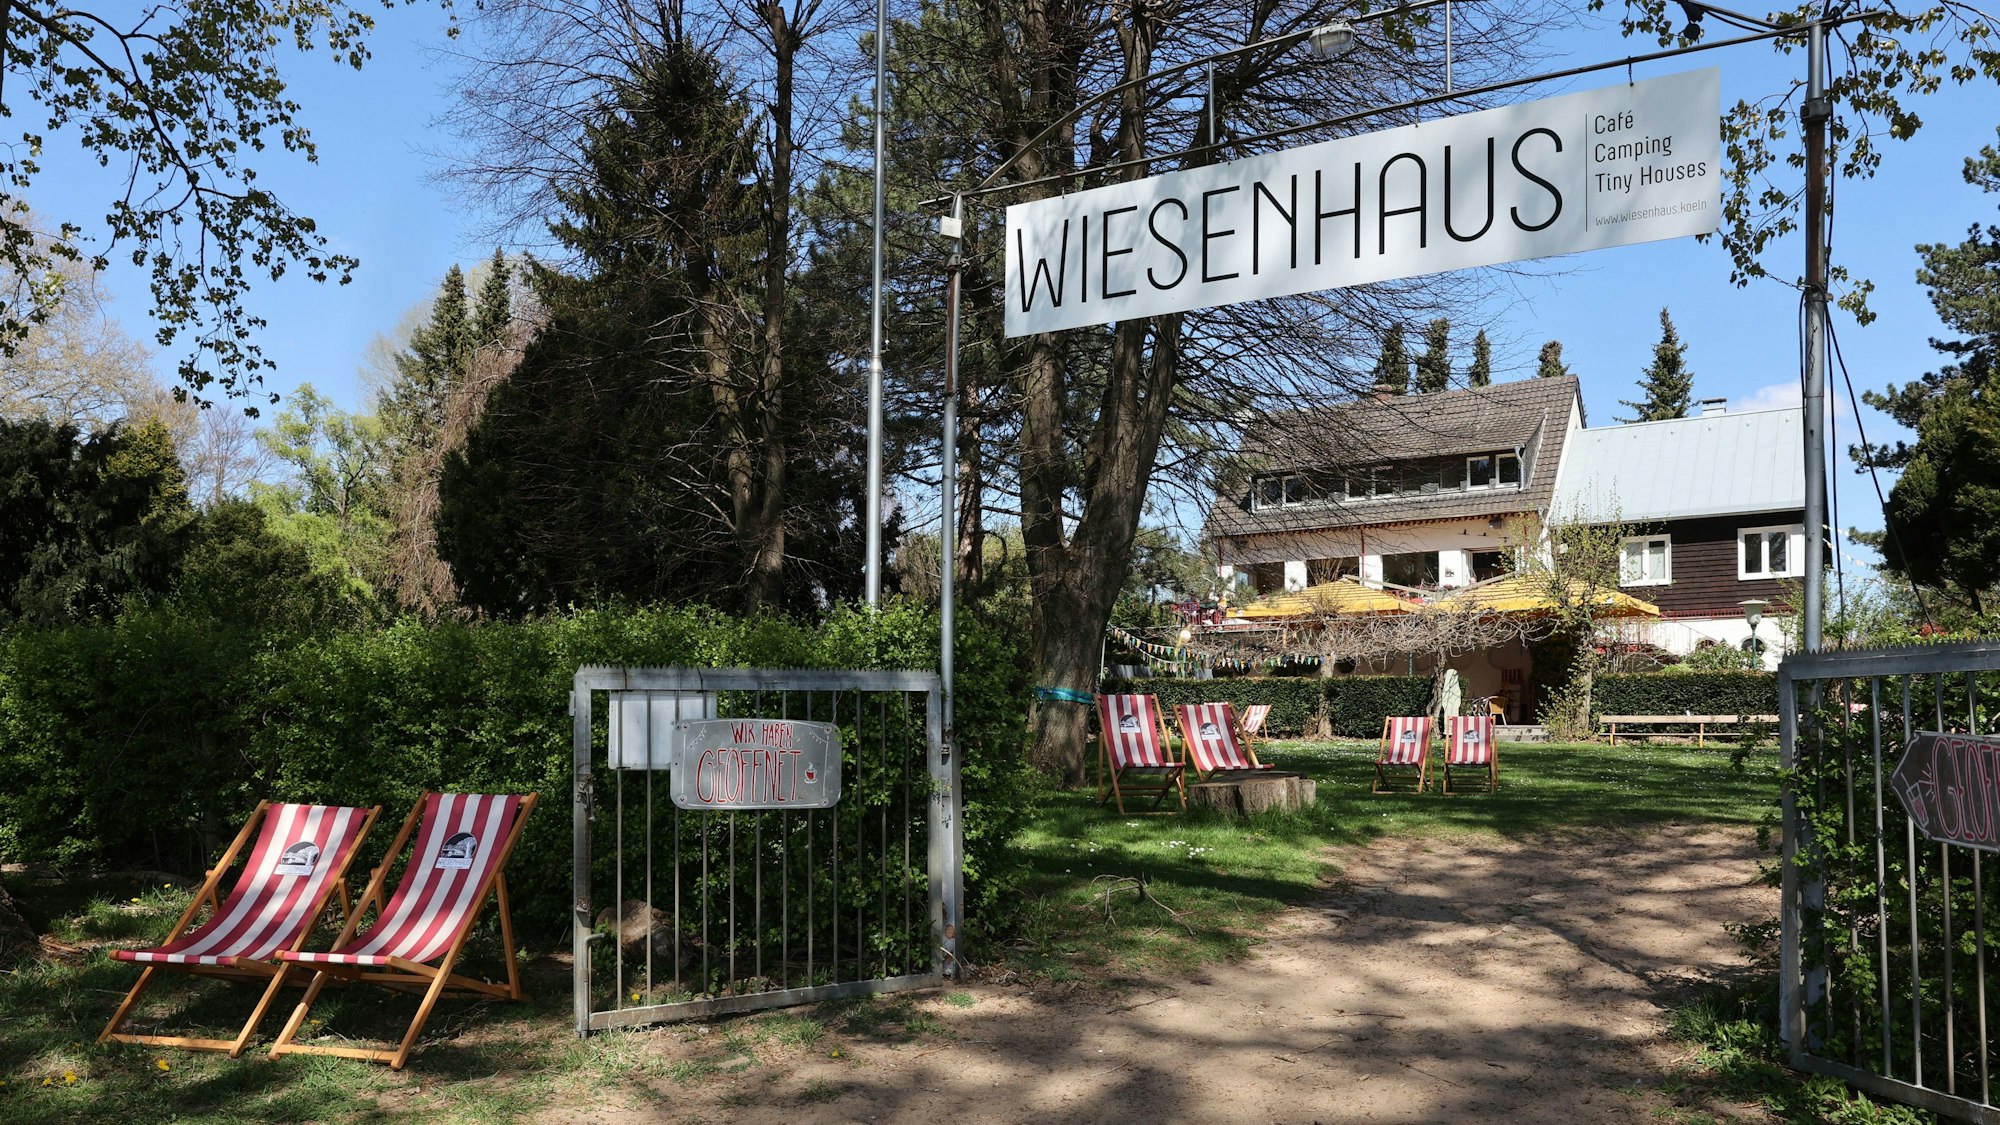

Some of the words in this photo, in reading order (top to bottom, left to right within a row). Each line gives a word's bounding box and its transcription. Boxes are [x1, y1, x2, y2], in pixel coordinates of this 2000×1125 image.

[1594, 110, 1634, 134] Café
[1594, 136, 1672, 162] Camping
[1595, 173, 1632, 194] Tiny
[1640, 162, 1706, 186] Houses
[1016, 126, 1563, 313] WIESENHAUS
[1595, 200, 1708, 226] www.wiesenhaus.koeln
[730, 721, 756, 744] WIR
[761, 722, 794, 749] HABEN
